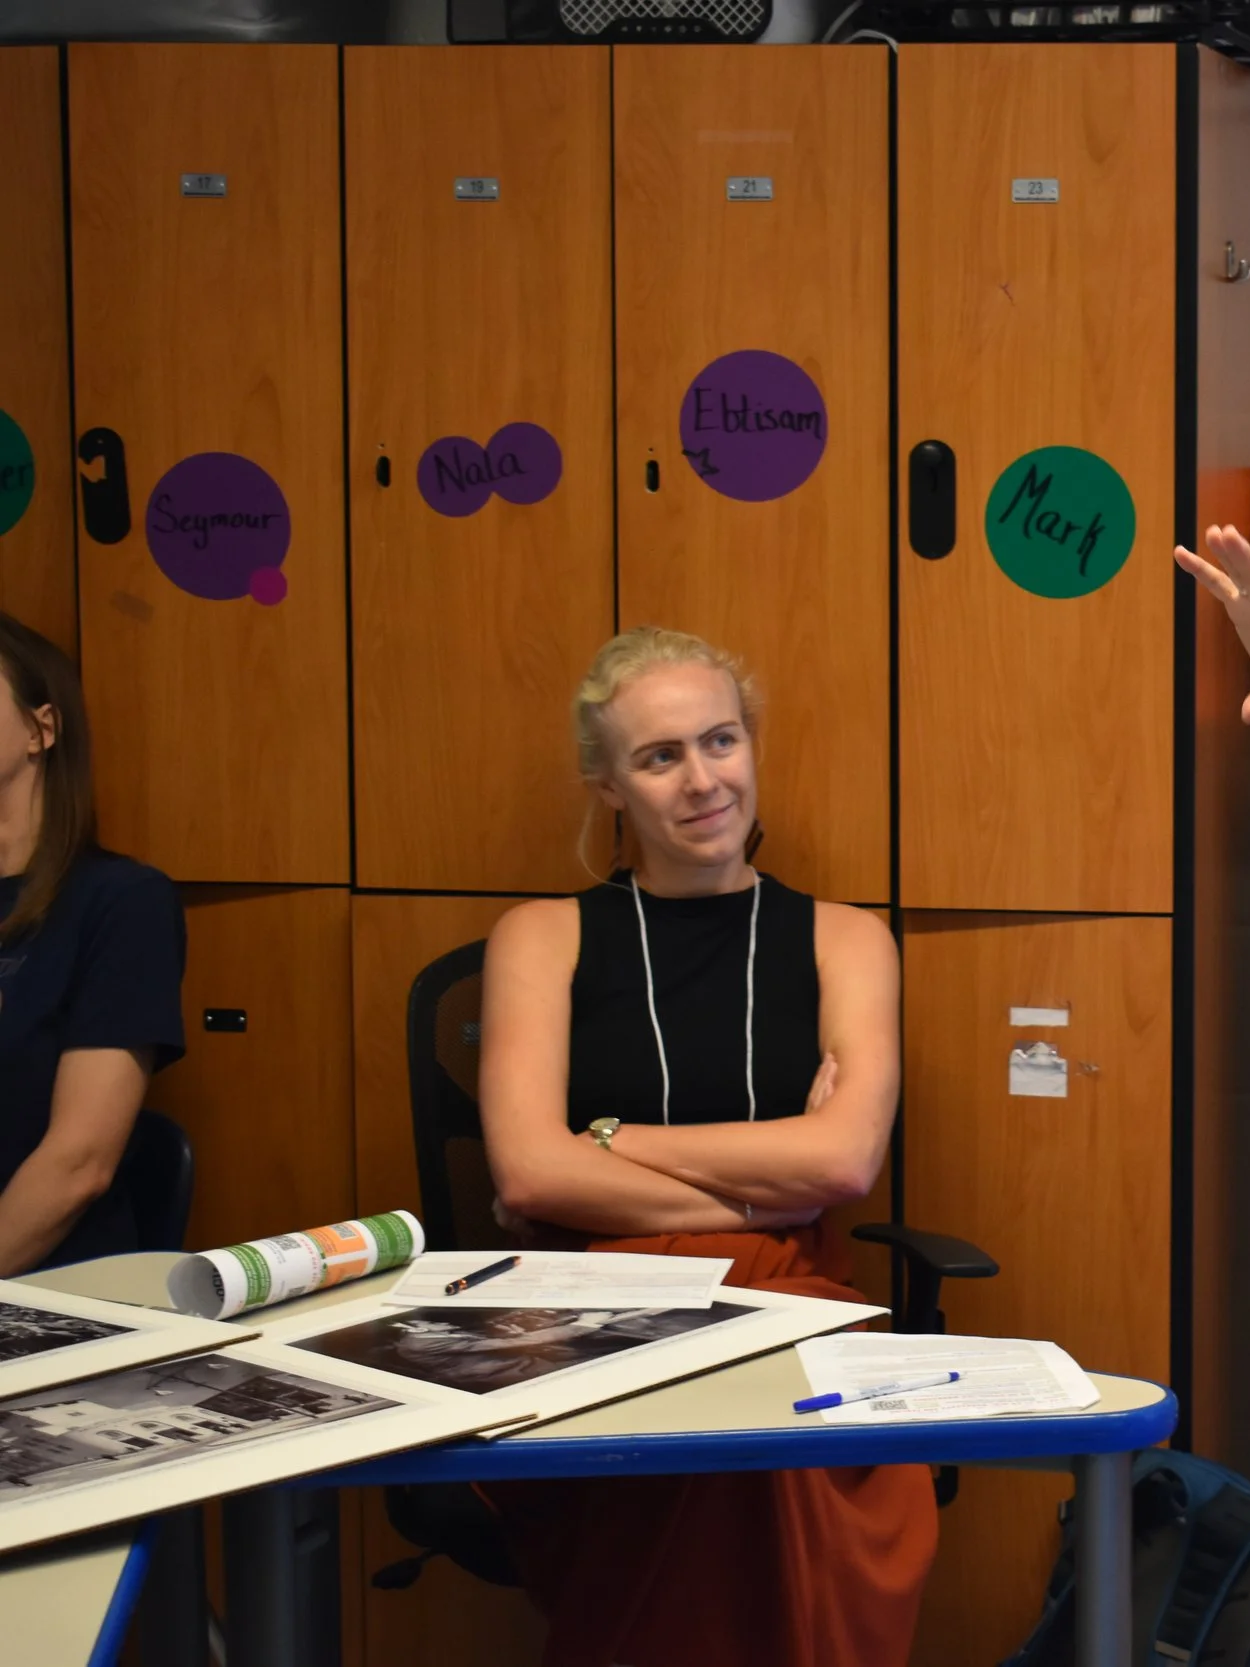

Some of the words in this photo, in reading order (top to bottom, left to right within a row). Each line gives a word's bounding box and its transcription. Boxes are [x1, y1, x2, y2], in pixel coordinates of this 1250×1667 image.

[198, 176, 212, 190] 17
[743, 179, 756, 193] 21
[1028, 181, 1043, 195] 23
[693, 388, 822, 439] Ebtisam
[434, 445, 526, 493] Nala
[152, 494, 281, 549] Seymour
[998, 463, 1106, 577] Mark
